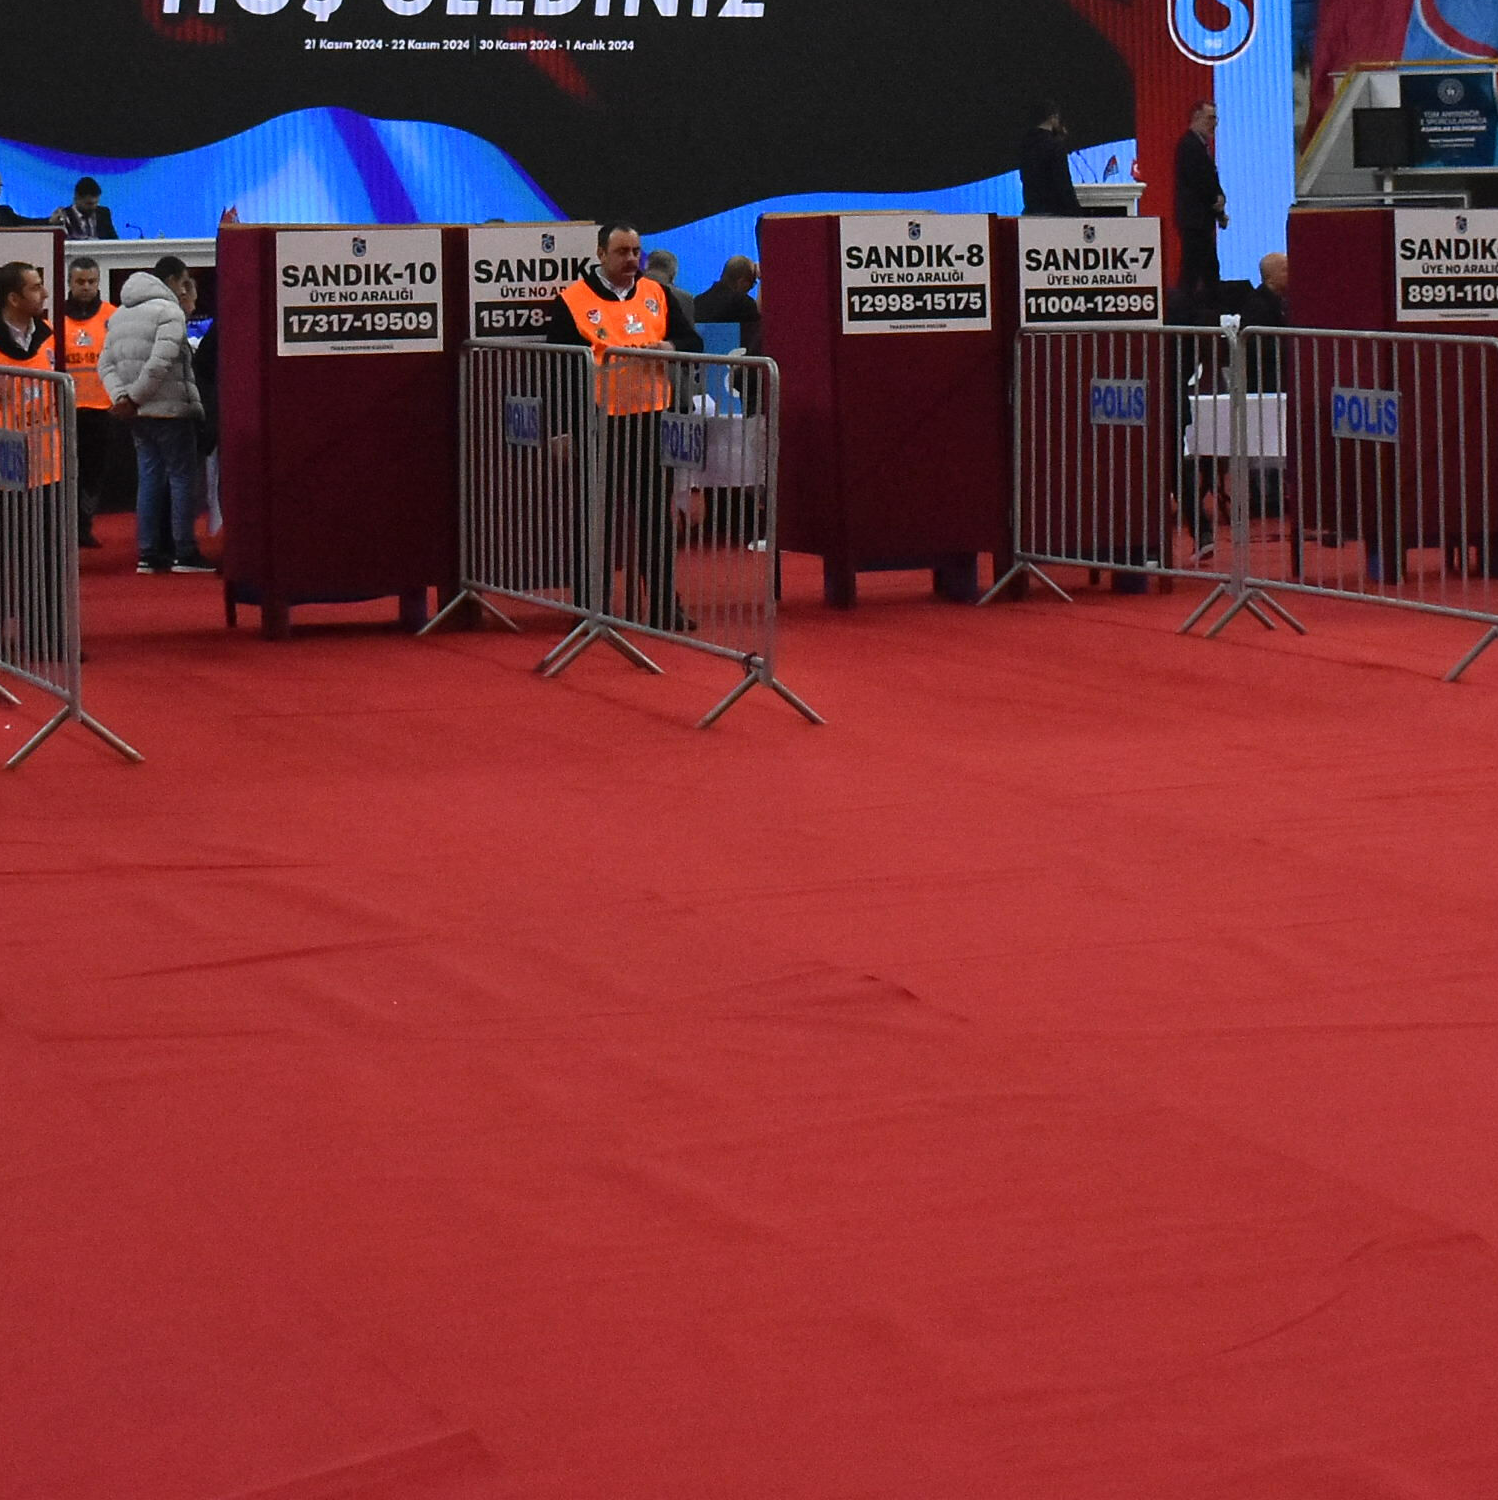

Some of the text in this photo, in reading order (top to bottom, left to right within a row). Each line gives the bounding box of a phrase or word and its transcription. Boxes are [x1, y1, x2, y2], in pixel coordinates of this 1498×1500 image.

[304, 39, 317, 50] 21
[319, 39, 353, 50] Kasım
[355, 39, 383, 50] 2024
[391, 39, 405, 50] 22
[407, 39, 440, 50] Kasım
[442, 39, 470, 50] 2024
[479, 39, 494, 50] 30
[495, 39, 528, 50] Kasım
[529, 39, 557, 50] 2024
[565, 39, 570, 50] 1
[573, 39, 606, 50] Aralık
[608, 39, 635, 50] 2024
[845, 244, 984, 269] SANDIK-8
[1025, 247, 1155, 271] SANDIK-7
[281, 261, 437, 288] SANDIK-10
[870, 269, 964, 284] ÜYE NO ARALIĞI
[1421, 262, 1443, 274] ÜYE
[1445, 264, 1461, 274] NO
[1047, 272, 1137, 286] ÜYE NO ARALIĞI
[310, 287, 413, 303] ÜYE NO ARALIĞI
[500, 285, 526, 298] ÜYE
[528, 286, 547, 298] NO
[851, 292, 982, 313] 12998-15175
[1027, 294, 1155, 314] 11004-12996
[288, 311, 433, 334] 17317-19509
